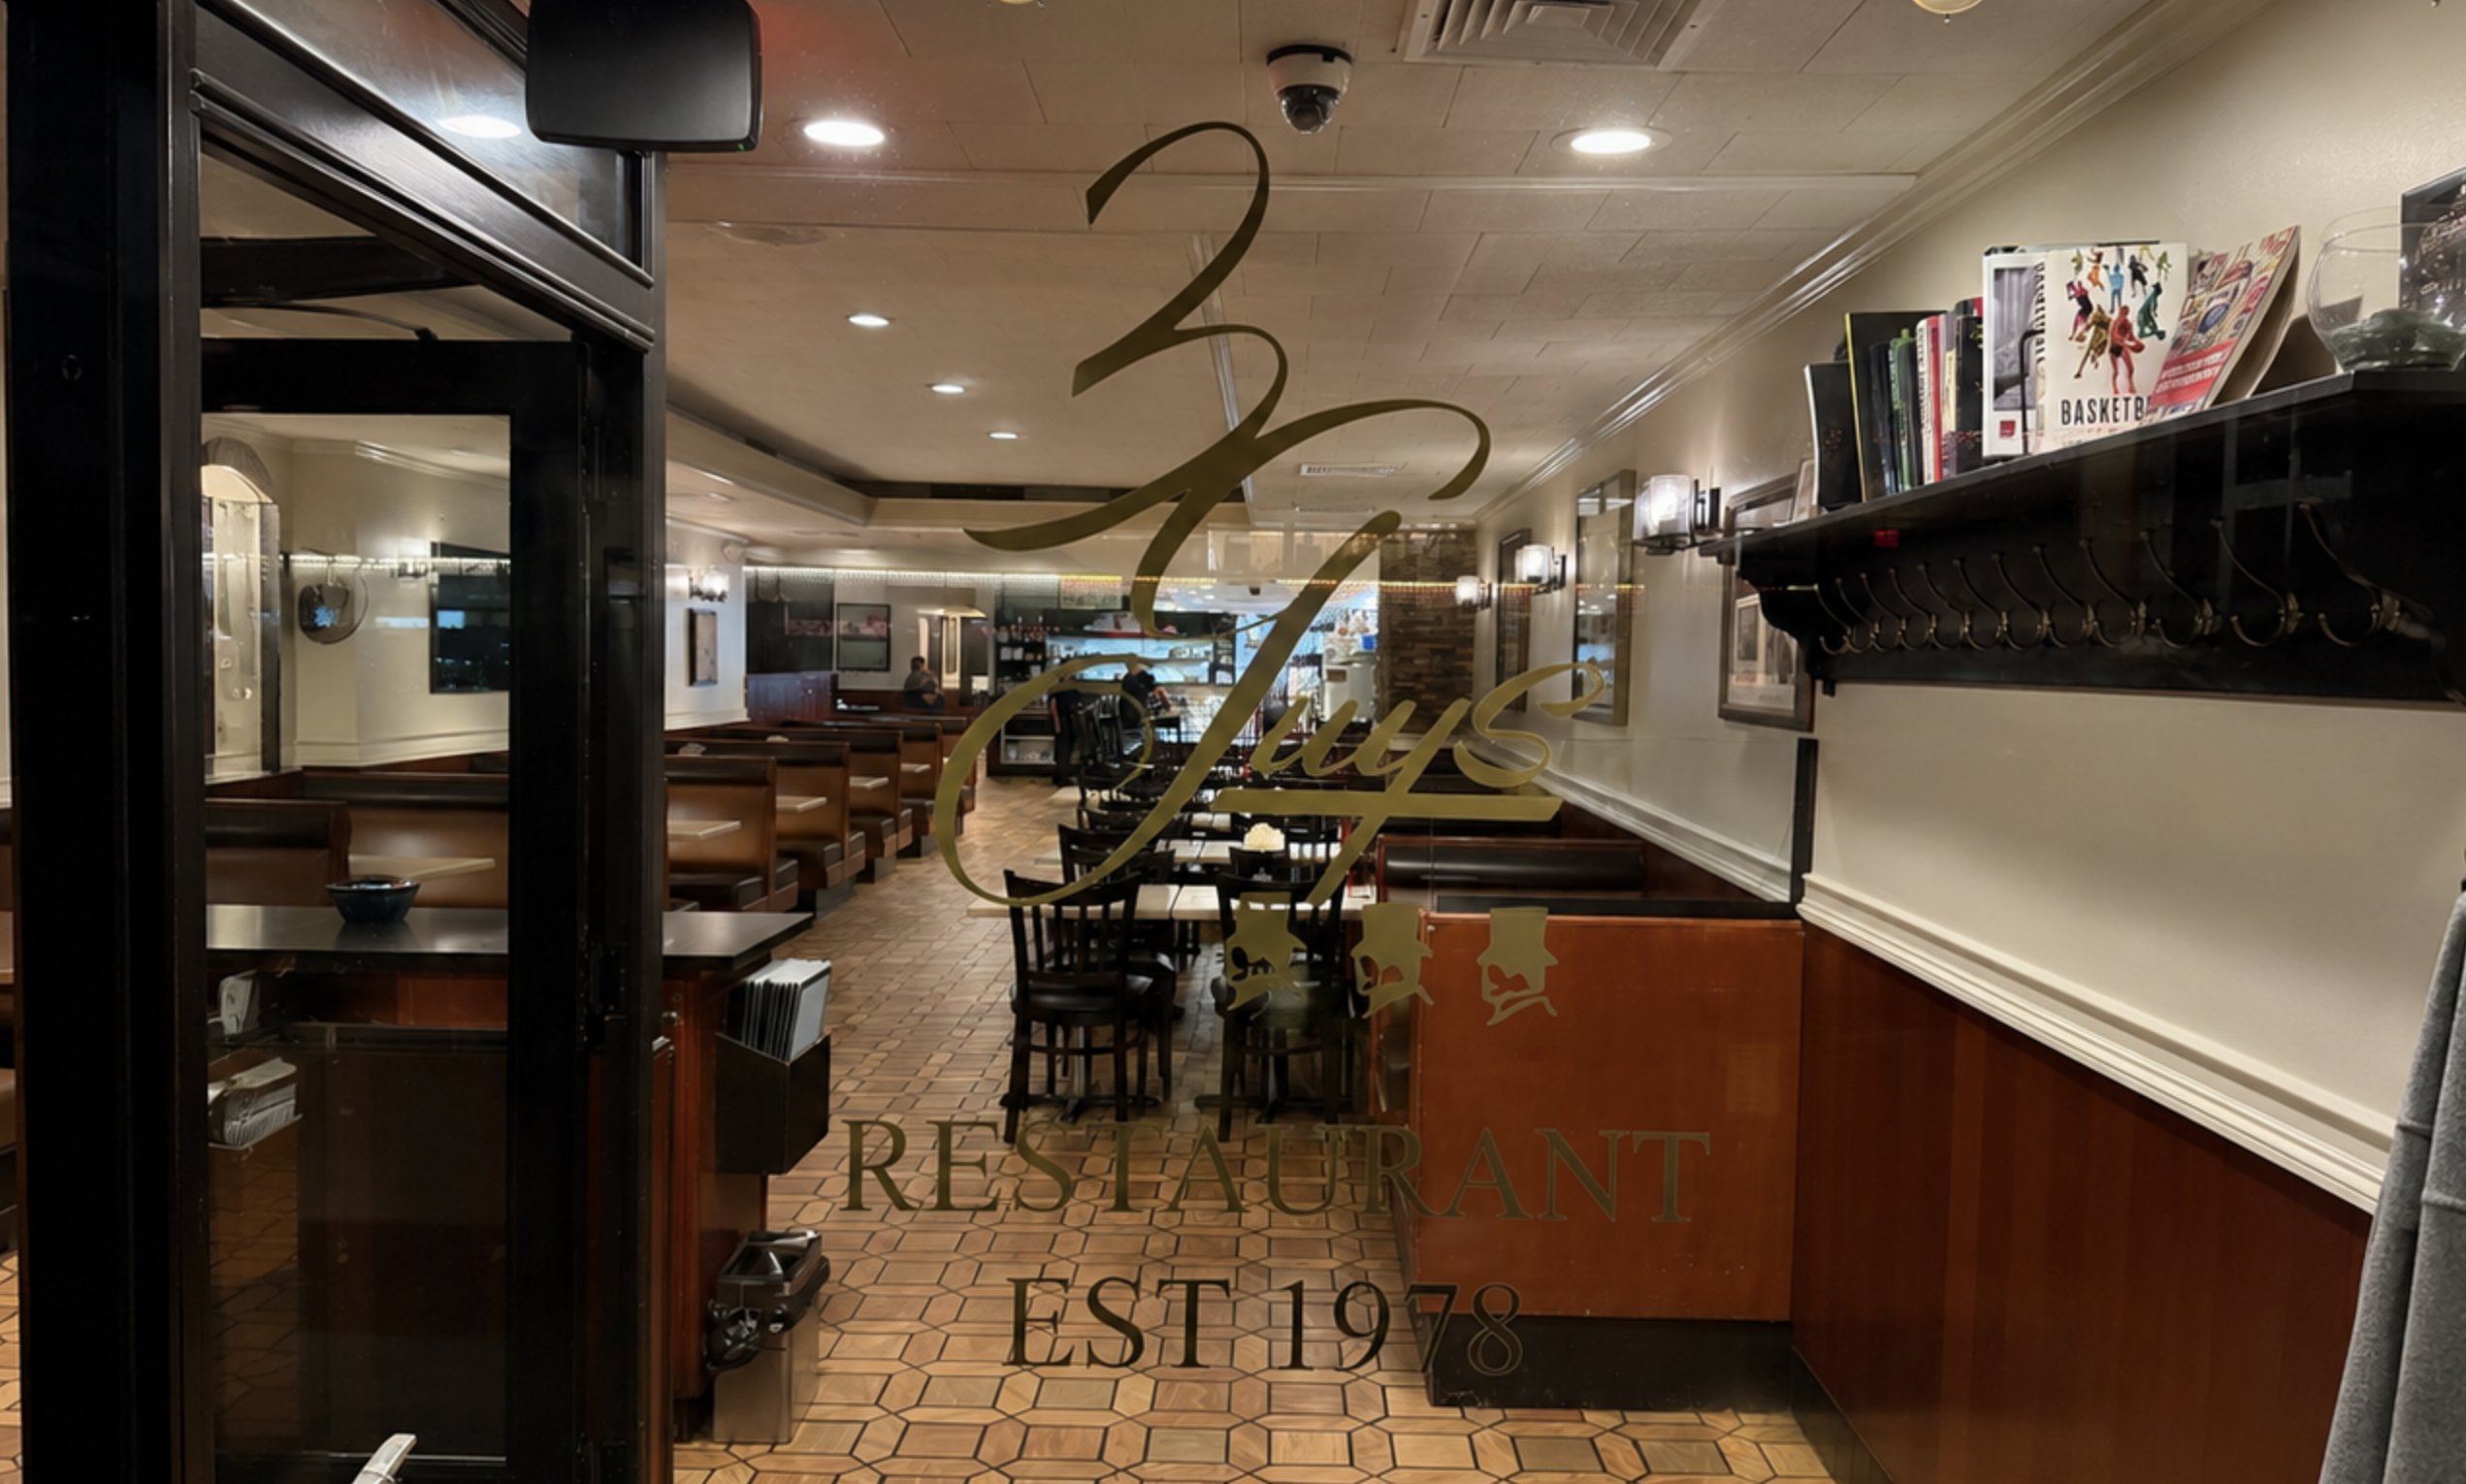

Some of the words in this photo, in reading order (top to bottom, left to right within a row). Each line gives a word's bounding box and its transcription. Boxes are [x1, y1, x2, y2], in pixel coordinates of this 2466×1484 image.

[963, 120, 1289, 551] 3
[2060, 394, 2151, 427] BASKETB
[933, 398, 1606, 907] Guys
[838, 1116, 1712, 1225] RESTAURANT
[1002, 1275, 1233, 1371] EST
[1275, 1278, 1524, 1378] 1978
